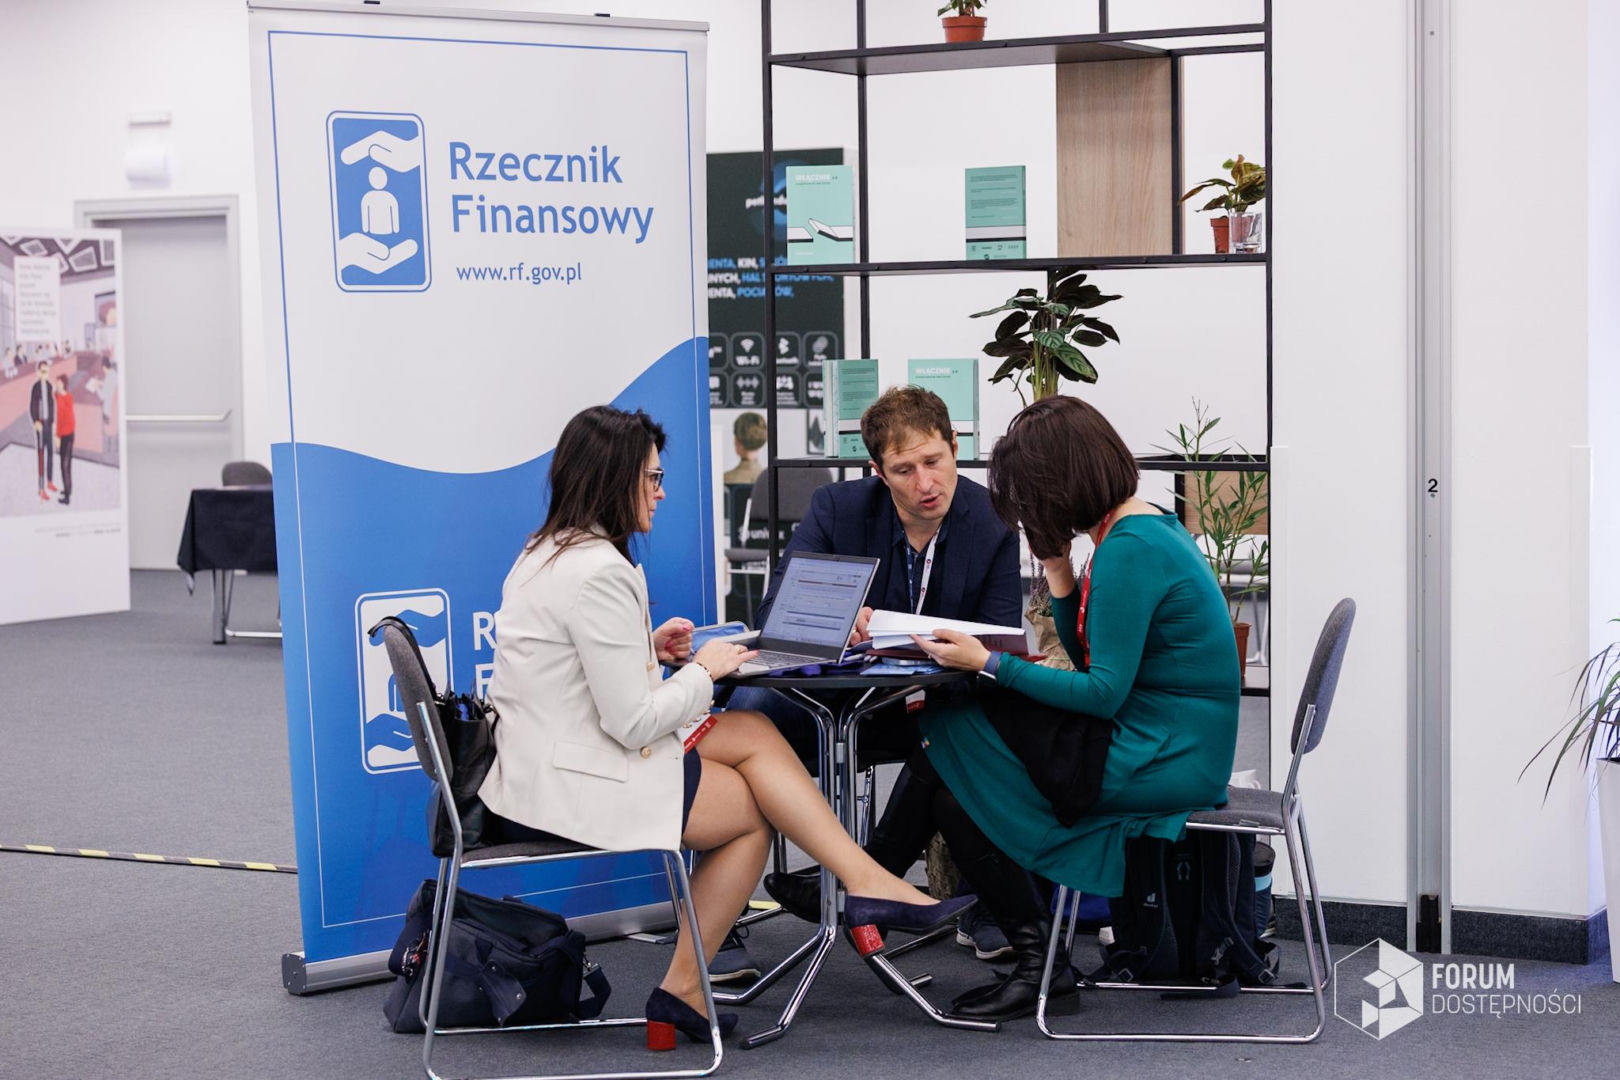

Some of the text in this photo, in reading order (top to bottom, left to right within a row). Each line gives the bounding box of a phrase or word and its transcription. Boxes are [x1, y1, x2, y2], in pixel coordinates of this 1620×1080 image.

[449, 141, 623, 183] Rzecznik
[452, 194, 654, 244] Finansowy
[456, 262, 582, 285] www.rf.gov.pl
[1428, 478, 1438, 492] 2
